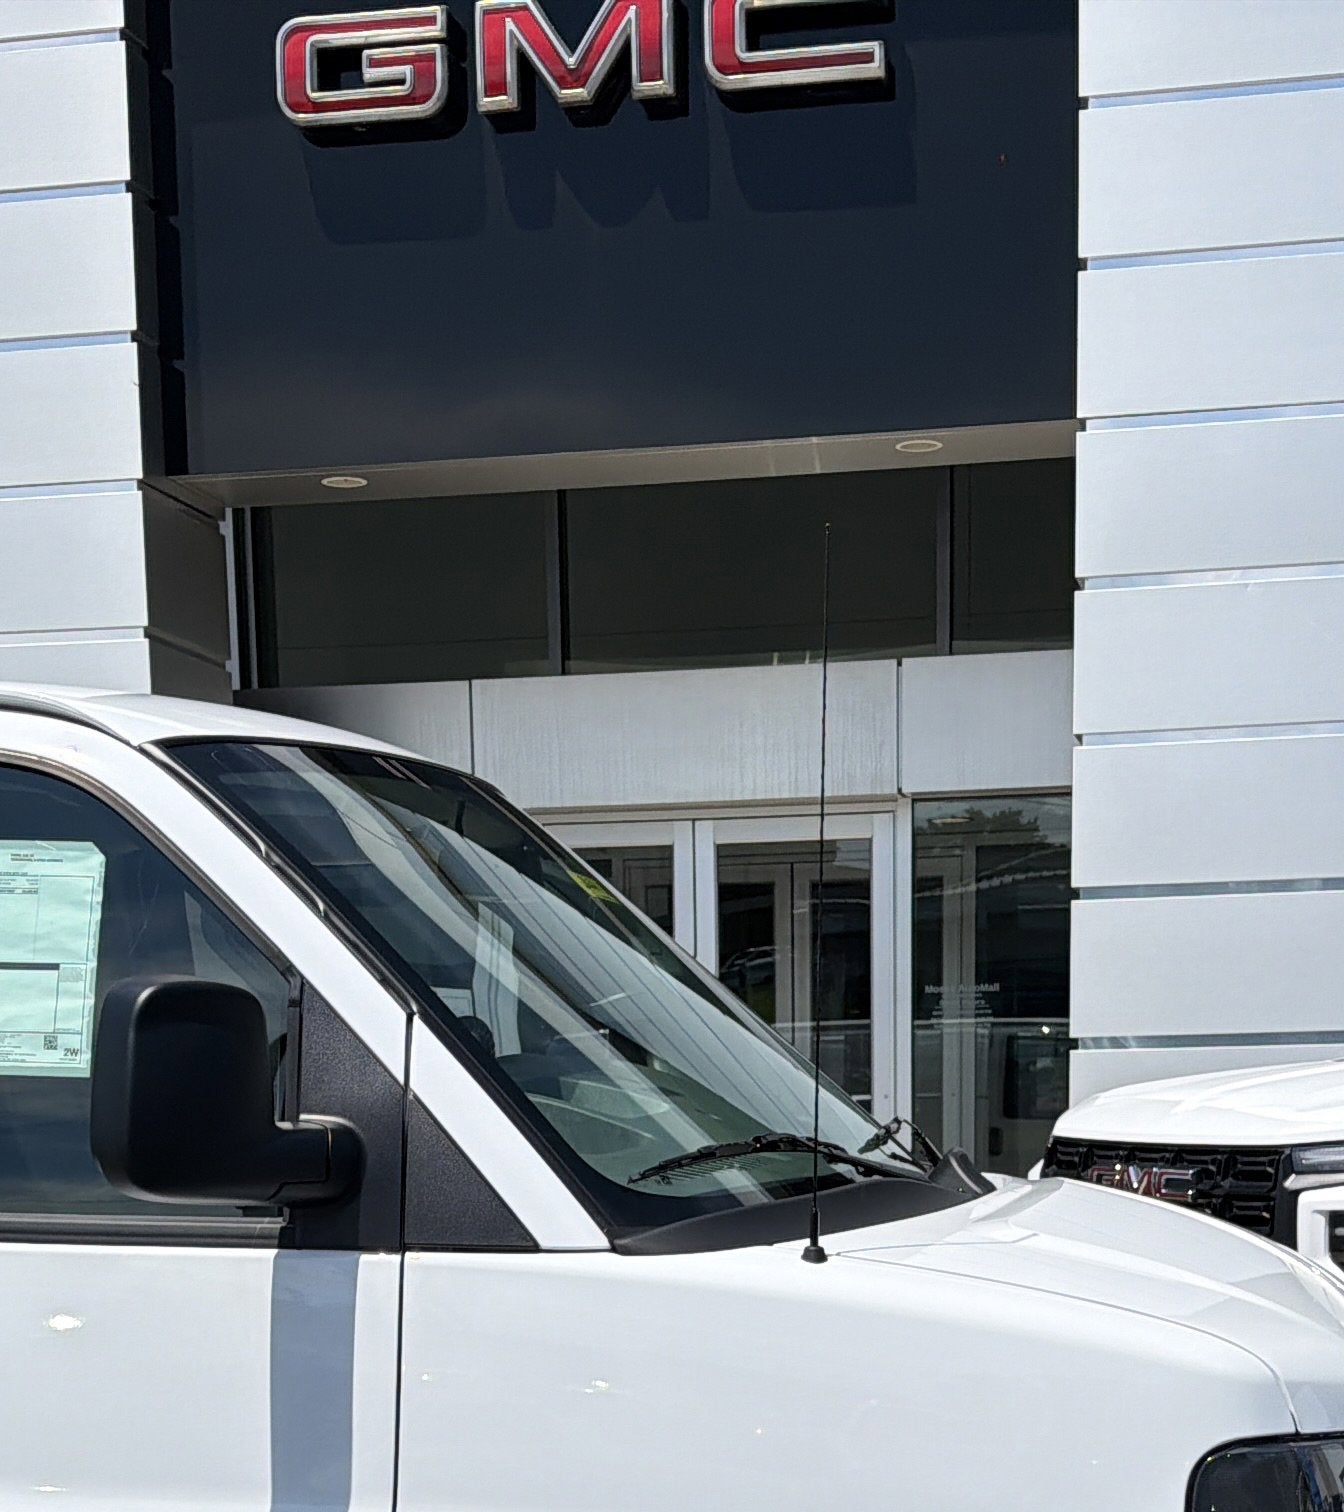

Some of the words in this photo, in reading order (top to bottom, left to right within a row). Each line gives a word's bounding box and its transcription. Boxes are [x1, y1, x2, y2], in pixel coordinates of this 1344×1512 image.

[276, 0, 885, 126] GMC
[63, 1048, 79, 1058] 2W
[1088, 1166, 1193, 1202] GMC
